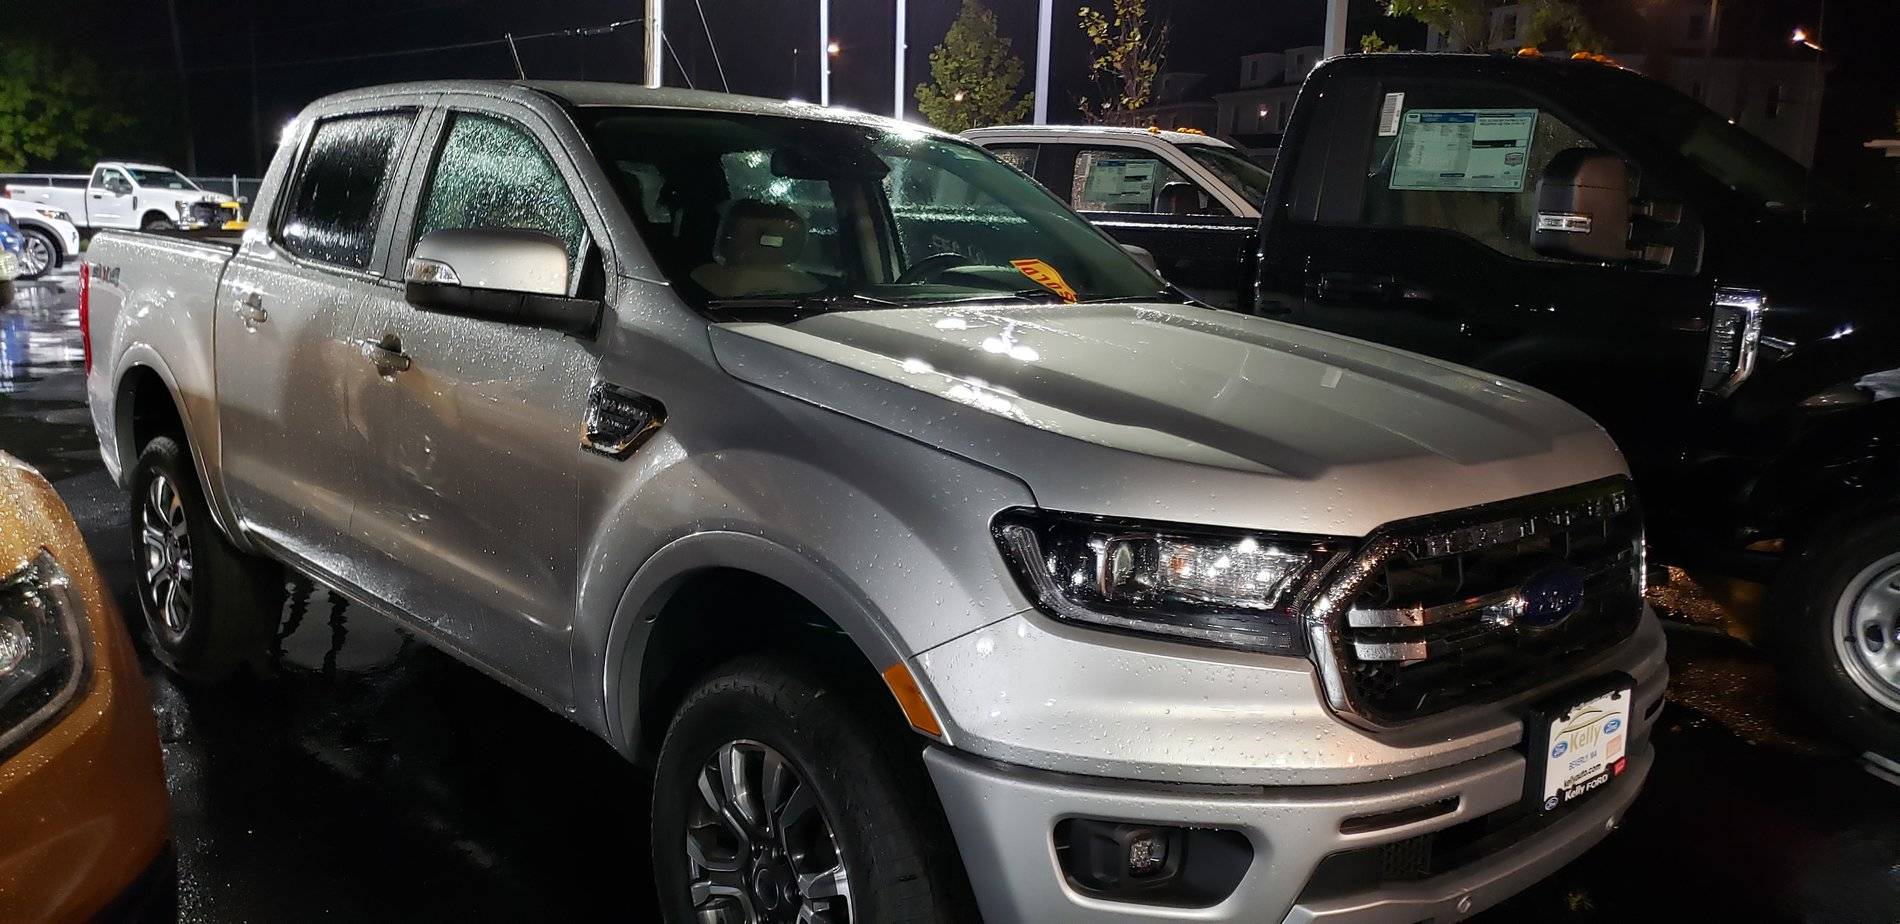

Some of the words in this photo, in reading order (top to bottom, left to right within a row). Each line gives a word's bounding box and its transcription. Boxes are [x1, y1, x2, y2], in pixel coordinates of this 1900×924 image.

[1569, 724, 1601, 752] Kelly
[1565, 784, 1585, 801] Kelly
[1586, 774, 1608, 791] FORD
